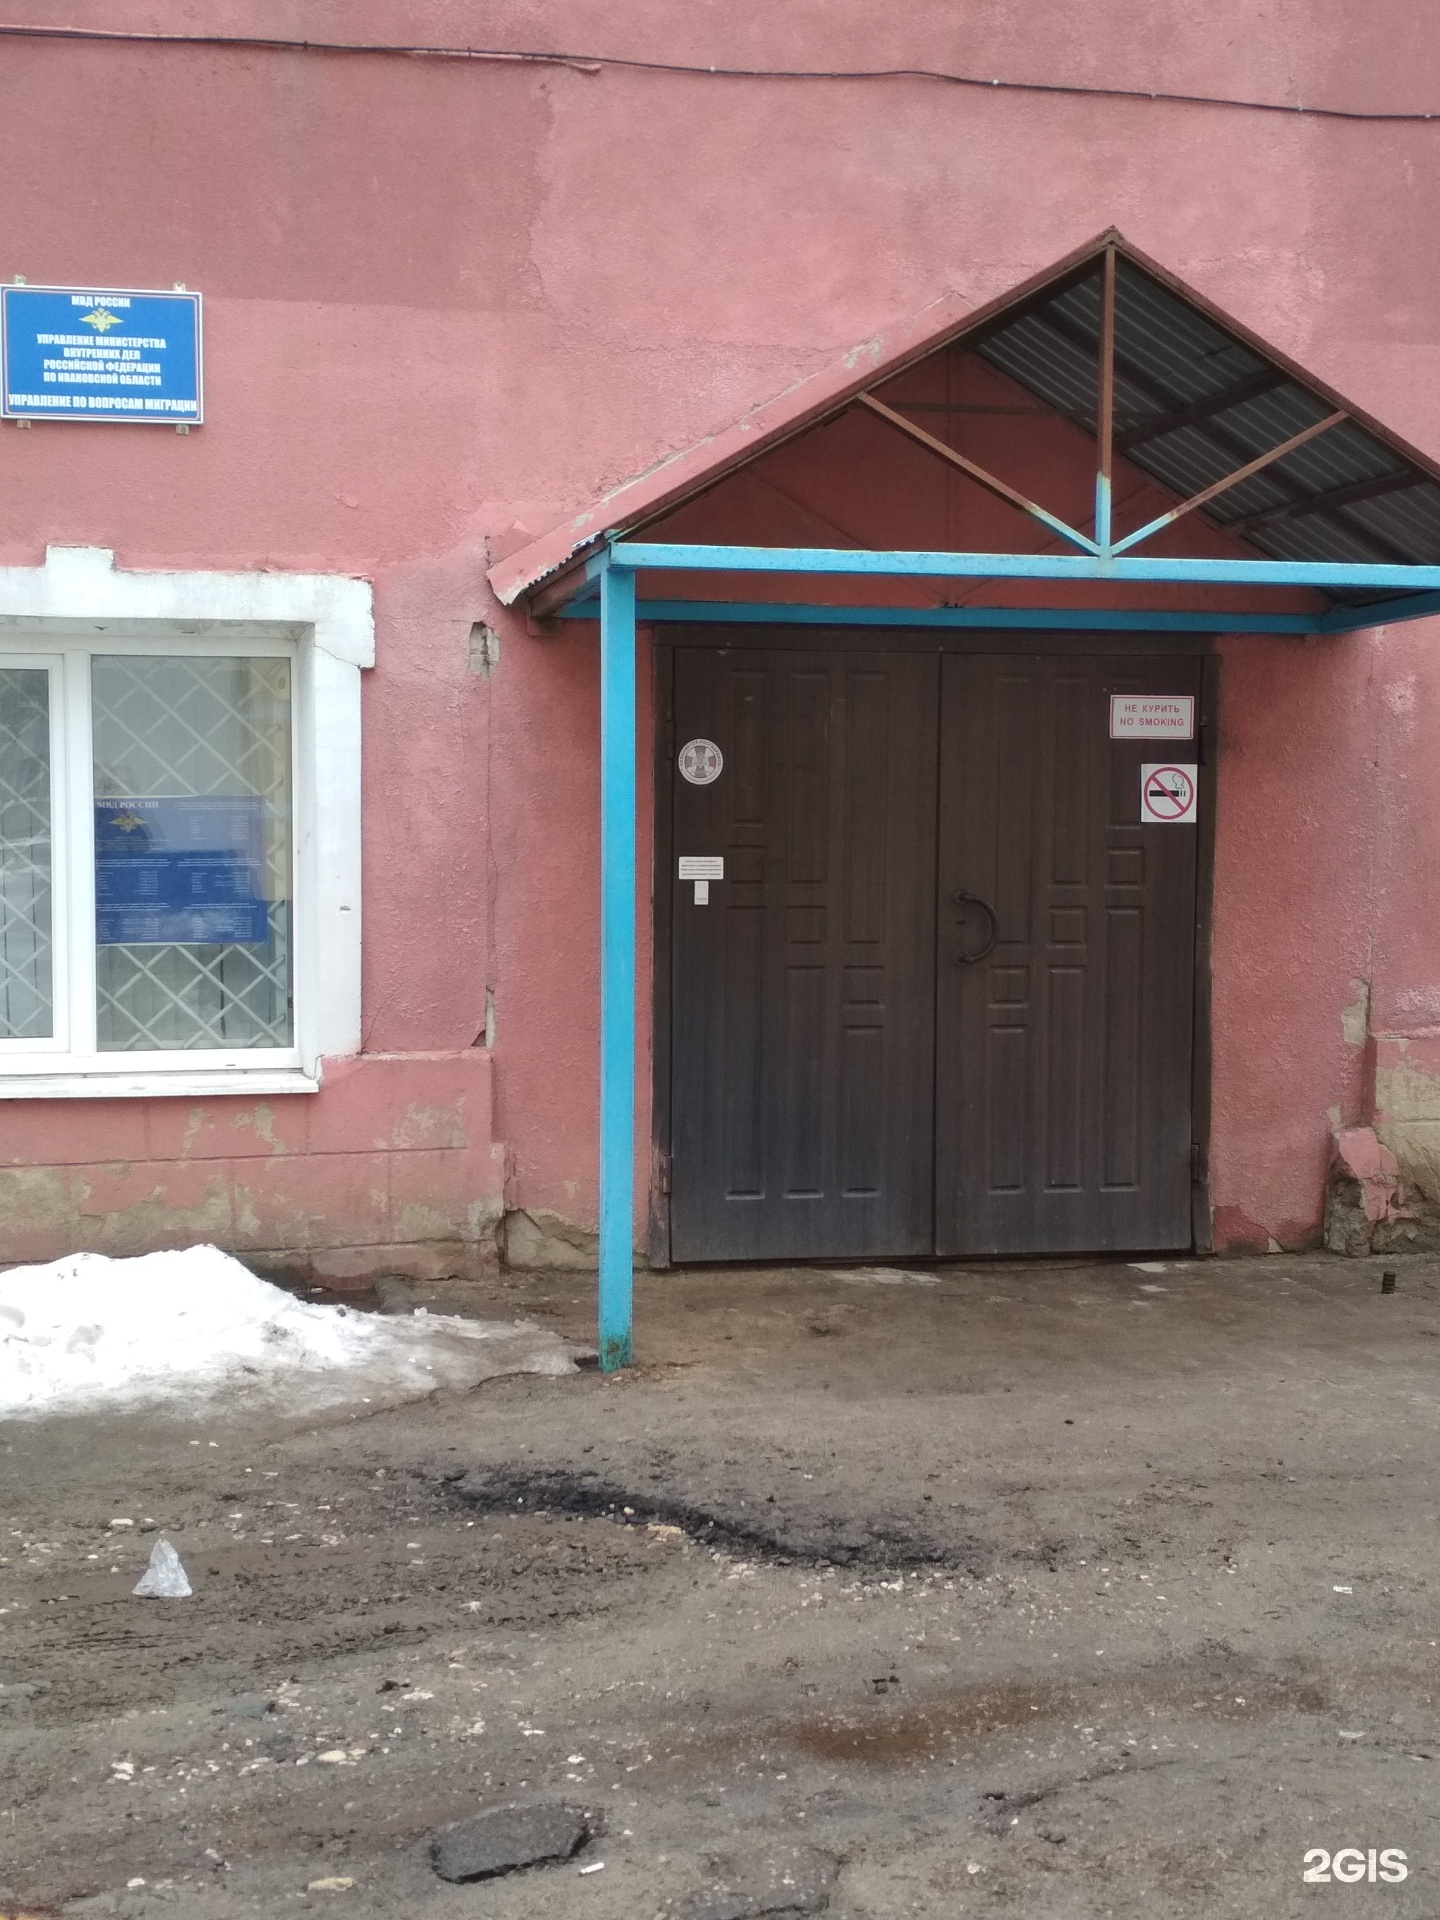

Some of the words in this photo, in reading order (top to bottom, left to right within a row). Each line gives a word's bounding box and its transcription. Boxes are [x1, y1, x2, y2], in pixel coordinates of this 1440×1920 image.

[71, 295, 93, 307] МВД
[94, 296, 131, 308] РОССИИ
[36, 333, 94, 346] УПРАВЛЕНИЕ
[95, 335, 167, 349] МИНИСТЕРСТВА
[63, 347, 121, 359] ВНУТРЕННИХ
[121, 349, 141, 361] ДЕЛ
[43, 358, 105, 372] РОССИЙСКОЙ
[105, 361, 161, 374] ФЕДЕРАЦИИ
[43, 371, 57, 383] ПО
[57, 372, 119, 384] ИВАНОВСКОЙ
[119, 374, 162, 386] ОБЛАСТИ
[8, 393, 72, 408] УПРАВЛЕНИЕ
[72, 395, 87, 408] ПО
[88, 396, 144, 410] ВОПРОСАМ
[144, 398, 198, 413] МИГРАЦИИ
[1124, 704, 1138, 713] НЕ
[1142, 704, 1180, 713] КУРИТЬ
[1119, 717, 1134, 726] NO
[1138, 717, 1185, 726] SMOKING
